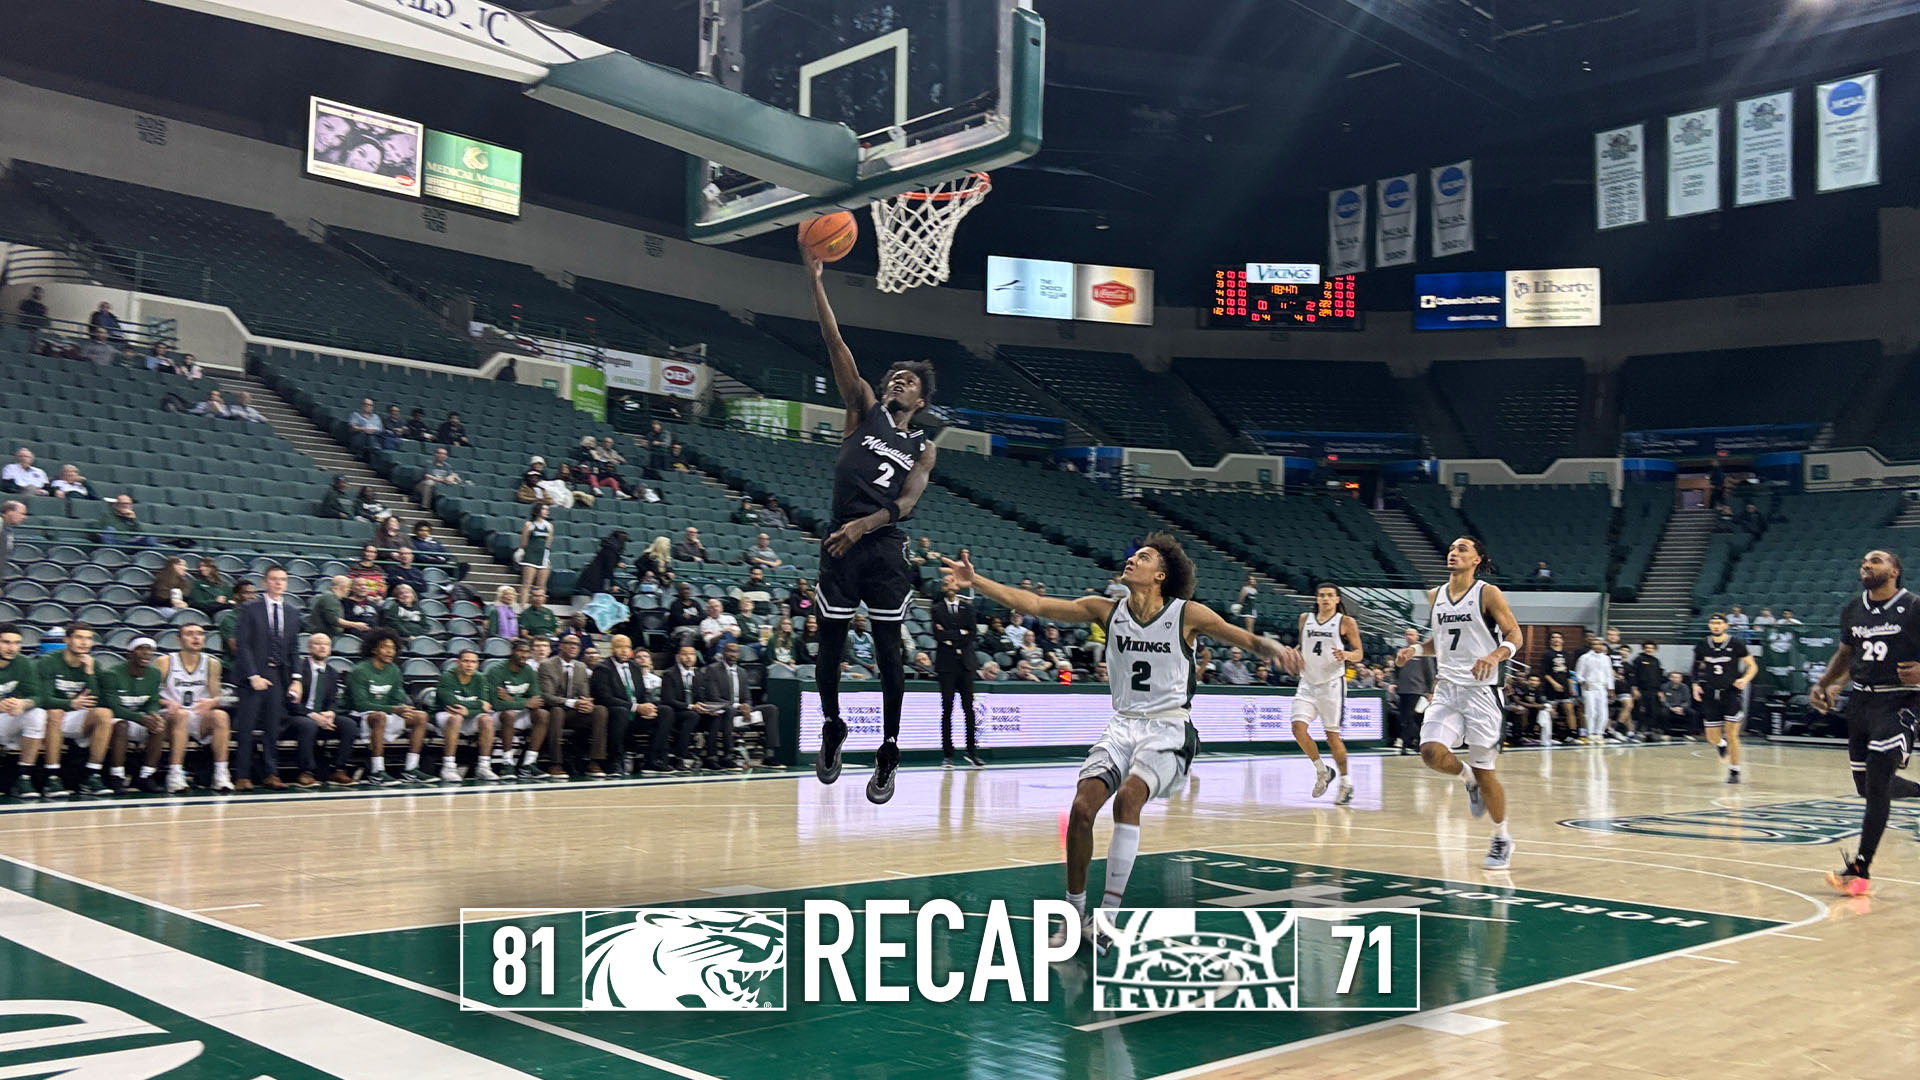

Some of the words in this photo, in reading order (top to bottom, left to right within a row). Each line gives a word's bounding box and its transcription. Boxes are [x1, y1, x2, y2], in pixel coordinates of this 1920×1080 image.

[872, 462, 895, 488] 2
[1437, 612, 1473, 625] VIKINGS
[1115, 635, 1171, 654] VIKINGS
[1312, 641, 1322, 656] 4
[1448, 628, 1461, 651] 7
[1862, 640, 1889, 661] 29
[1131, 660, 1151, 692] 2
[1713, 664, 1725, 675] 3
[1168, 855, 1414, 889] LEAGUE
[1411, 886, 1709, 928] HORIZON
